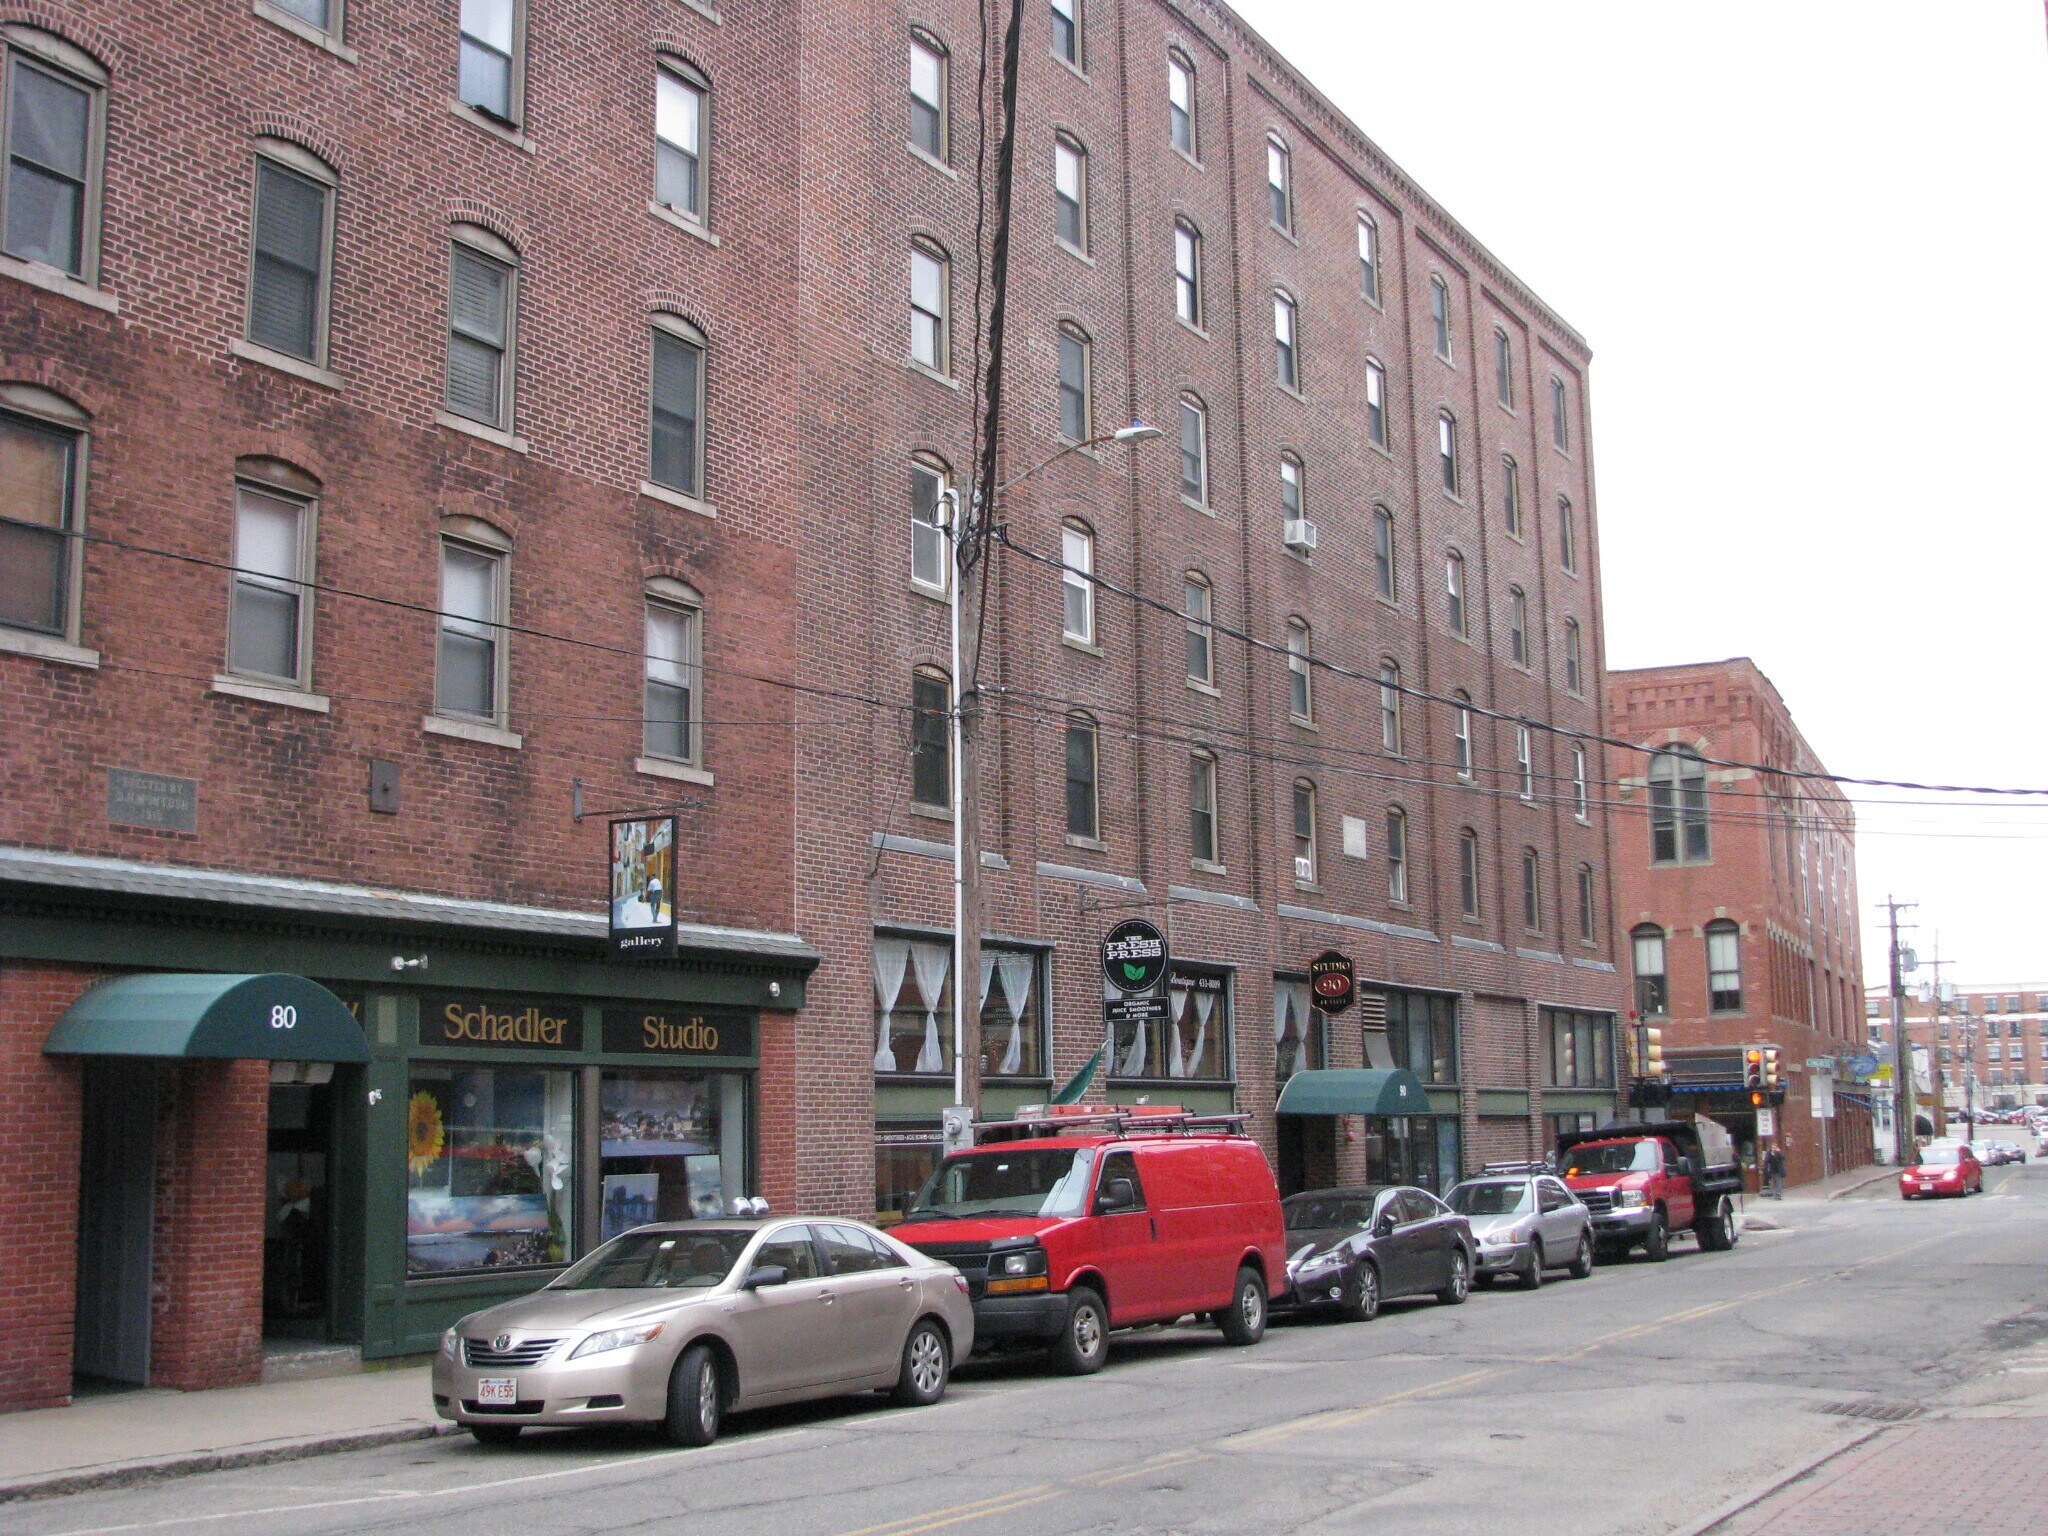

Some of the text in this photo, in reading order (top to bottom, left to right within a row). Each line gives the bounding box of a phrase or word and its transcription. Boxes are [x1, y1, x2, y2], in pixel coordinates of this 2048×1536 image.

[620, 935, 664, 949] gallery
[1106, 940, 1161, 951] FRESH
[1106, 948, 1161, 960] PRESS
[1312, 961, 1350, 971] STUDIO
[1322, 979, 1341, 990] 90
[271, 1004, 297, 1029] 80
[442, 1002, 719, 1051] Schadler Studio
[498, 1385, 514, 1398] E55
